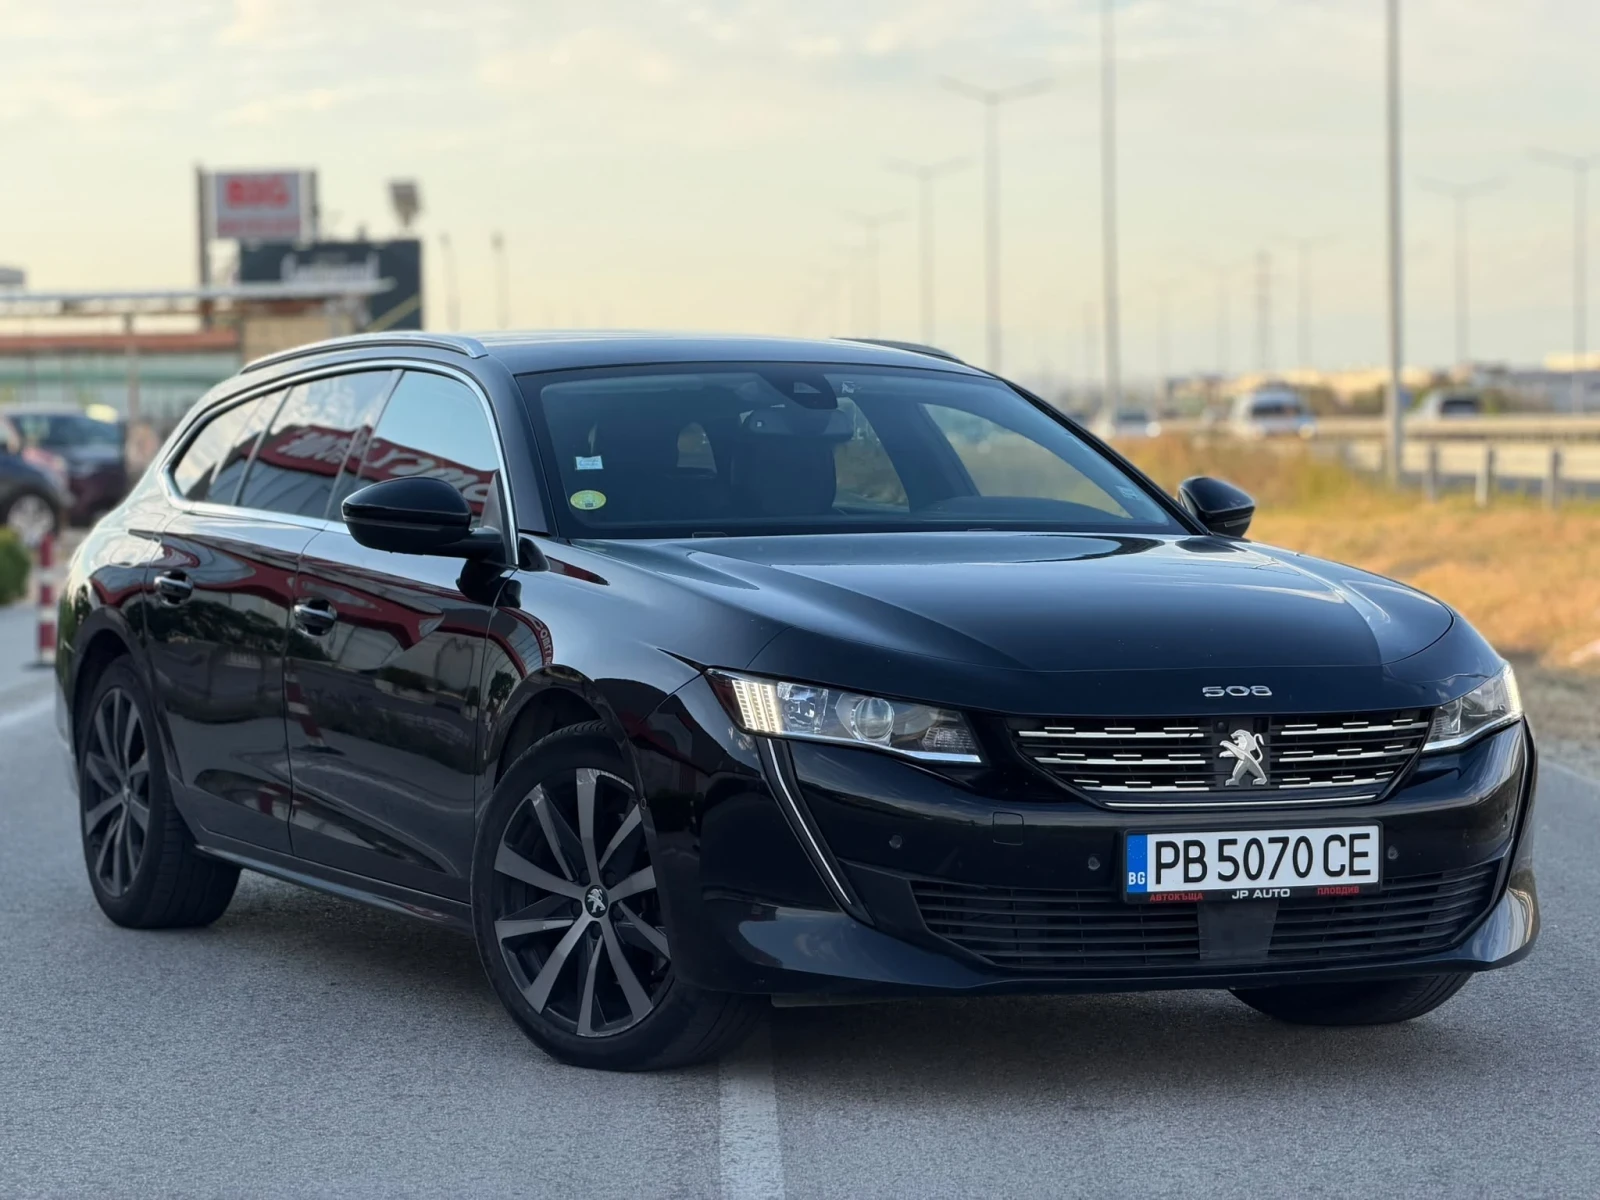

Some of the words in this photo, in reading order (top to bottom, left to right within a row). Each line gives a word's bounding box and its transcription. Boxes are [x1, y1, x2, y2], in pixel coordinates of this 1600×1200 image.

[1202, 685, 1272, 697] 508
[1155, 840, 1208, 885] PB
[1217, 836, 1313, 881] 5070
[1323, 833, 1371, 877] CE
[1128, 872, 1146, 886] BG
[1231, 889, 1249, 900] JP
[1253, 888, 1291, 899] AUTO
[1317, 885, 1360, 896] ПЛОВДИВ
[1150, 892, 1204, 902] АВТОКЪЩА
